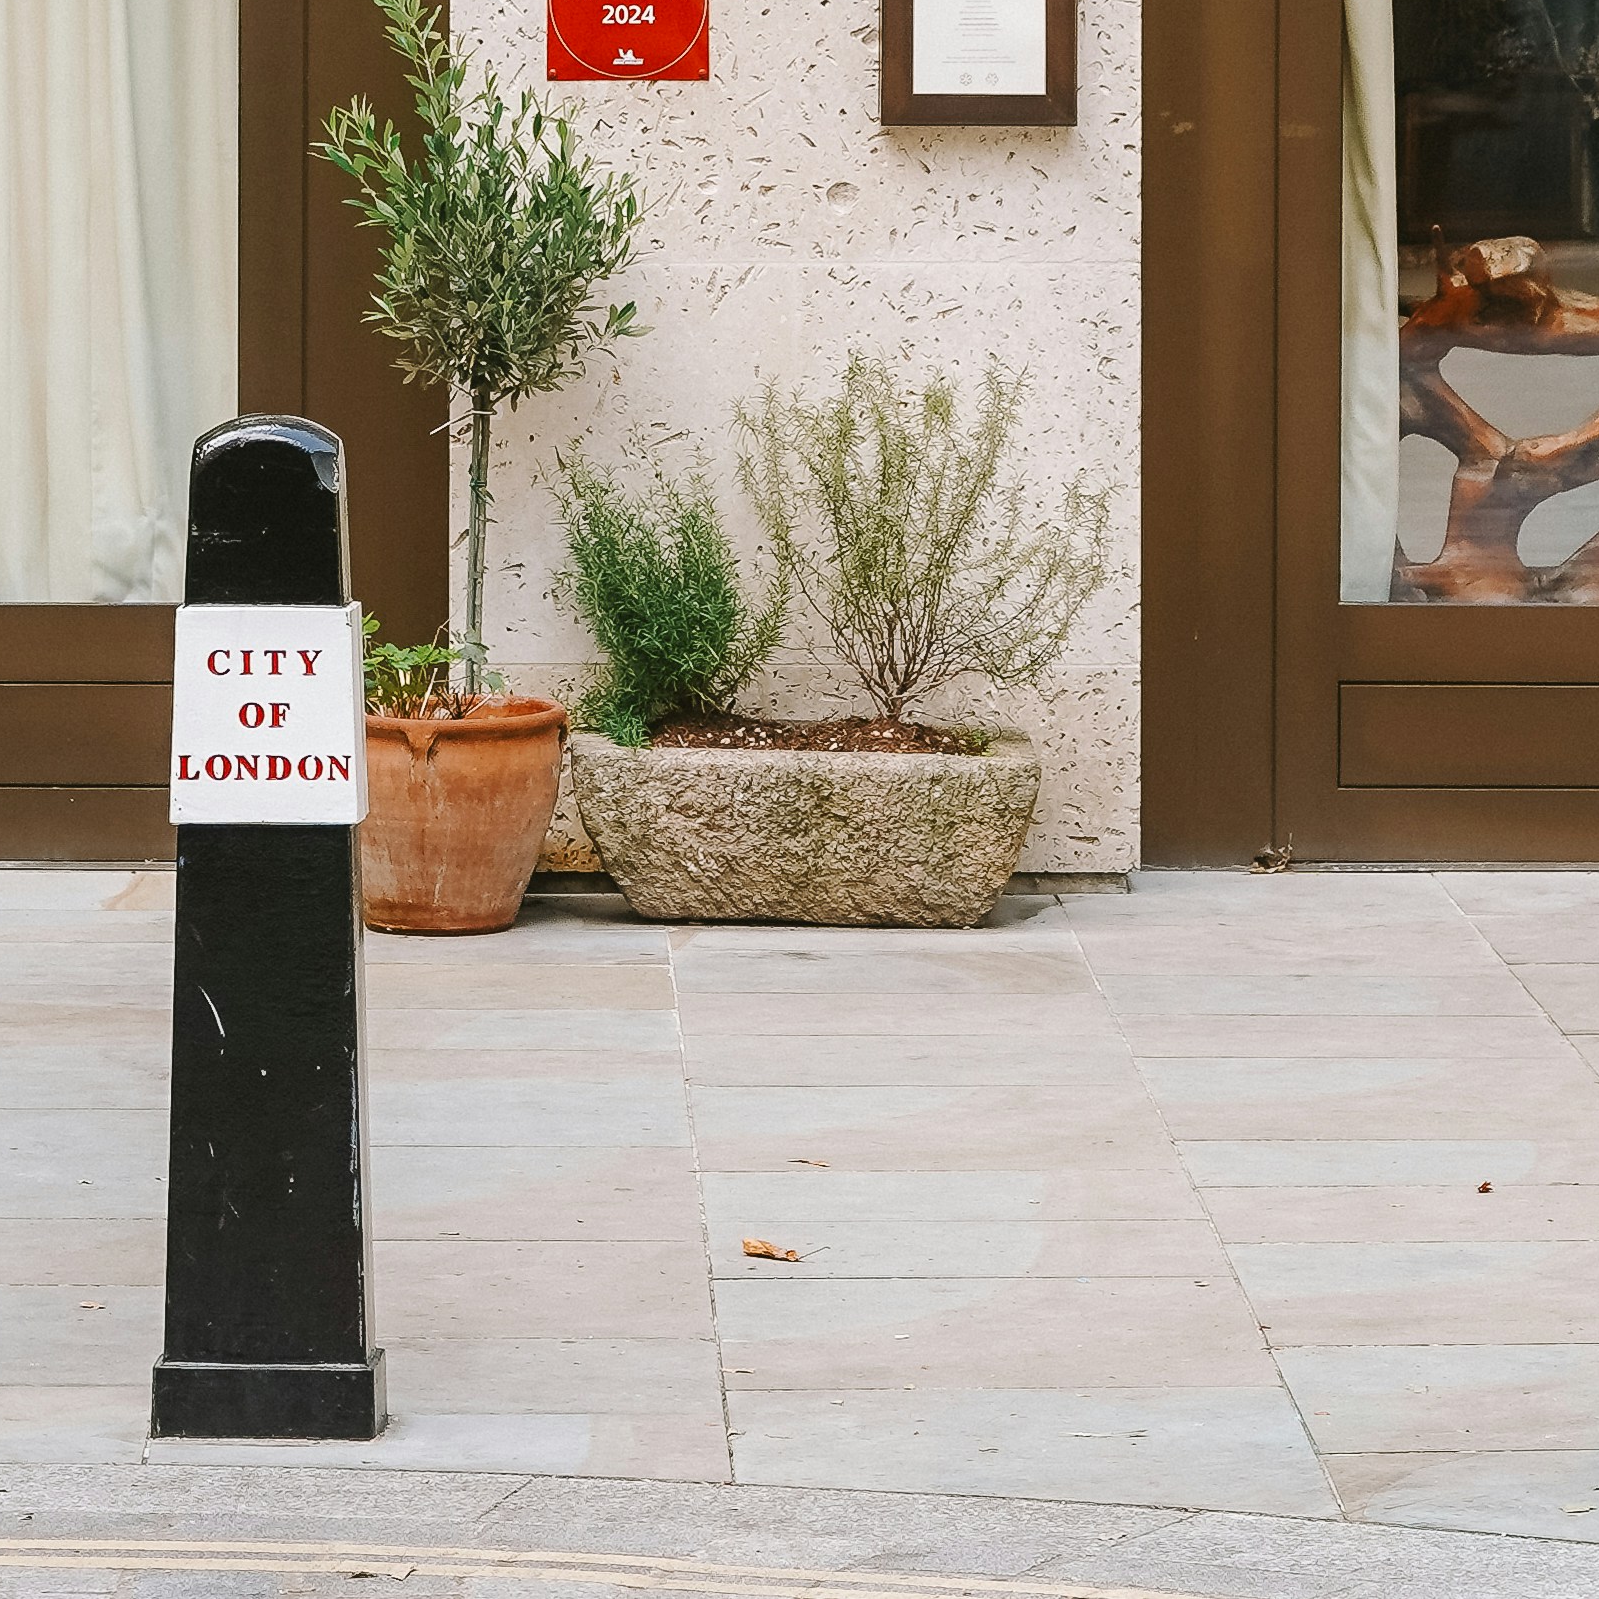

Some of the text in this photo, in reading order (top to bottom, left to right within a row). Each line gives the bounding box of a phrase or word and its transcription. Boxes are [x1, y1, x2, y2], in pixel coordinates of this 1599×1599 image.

[602, 5, 656, 25] 2024
[207, 650, 322, 676] CITY
[238, 702, 290, 729] OF
[177, 754, 352, 781] LONDON
